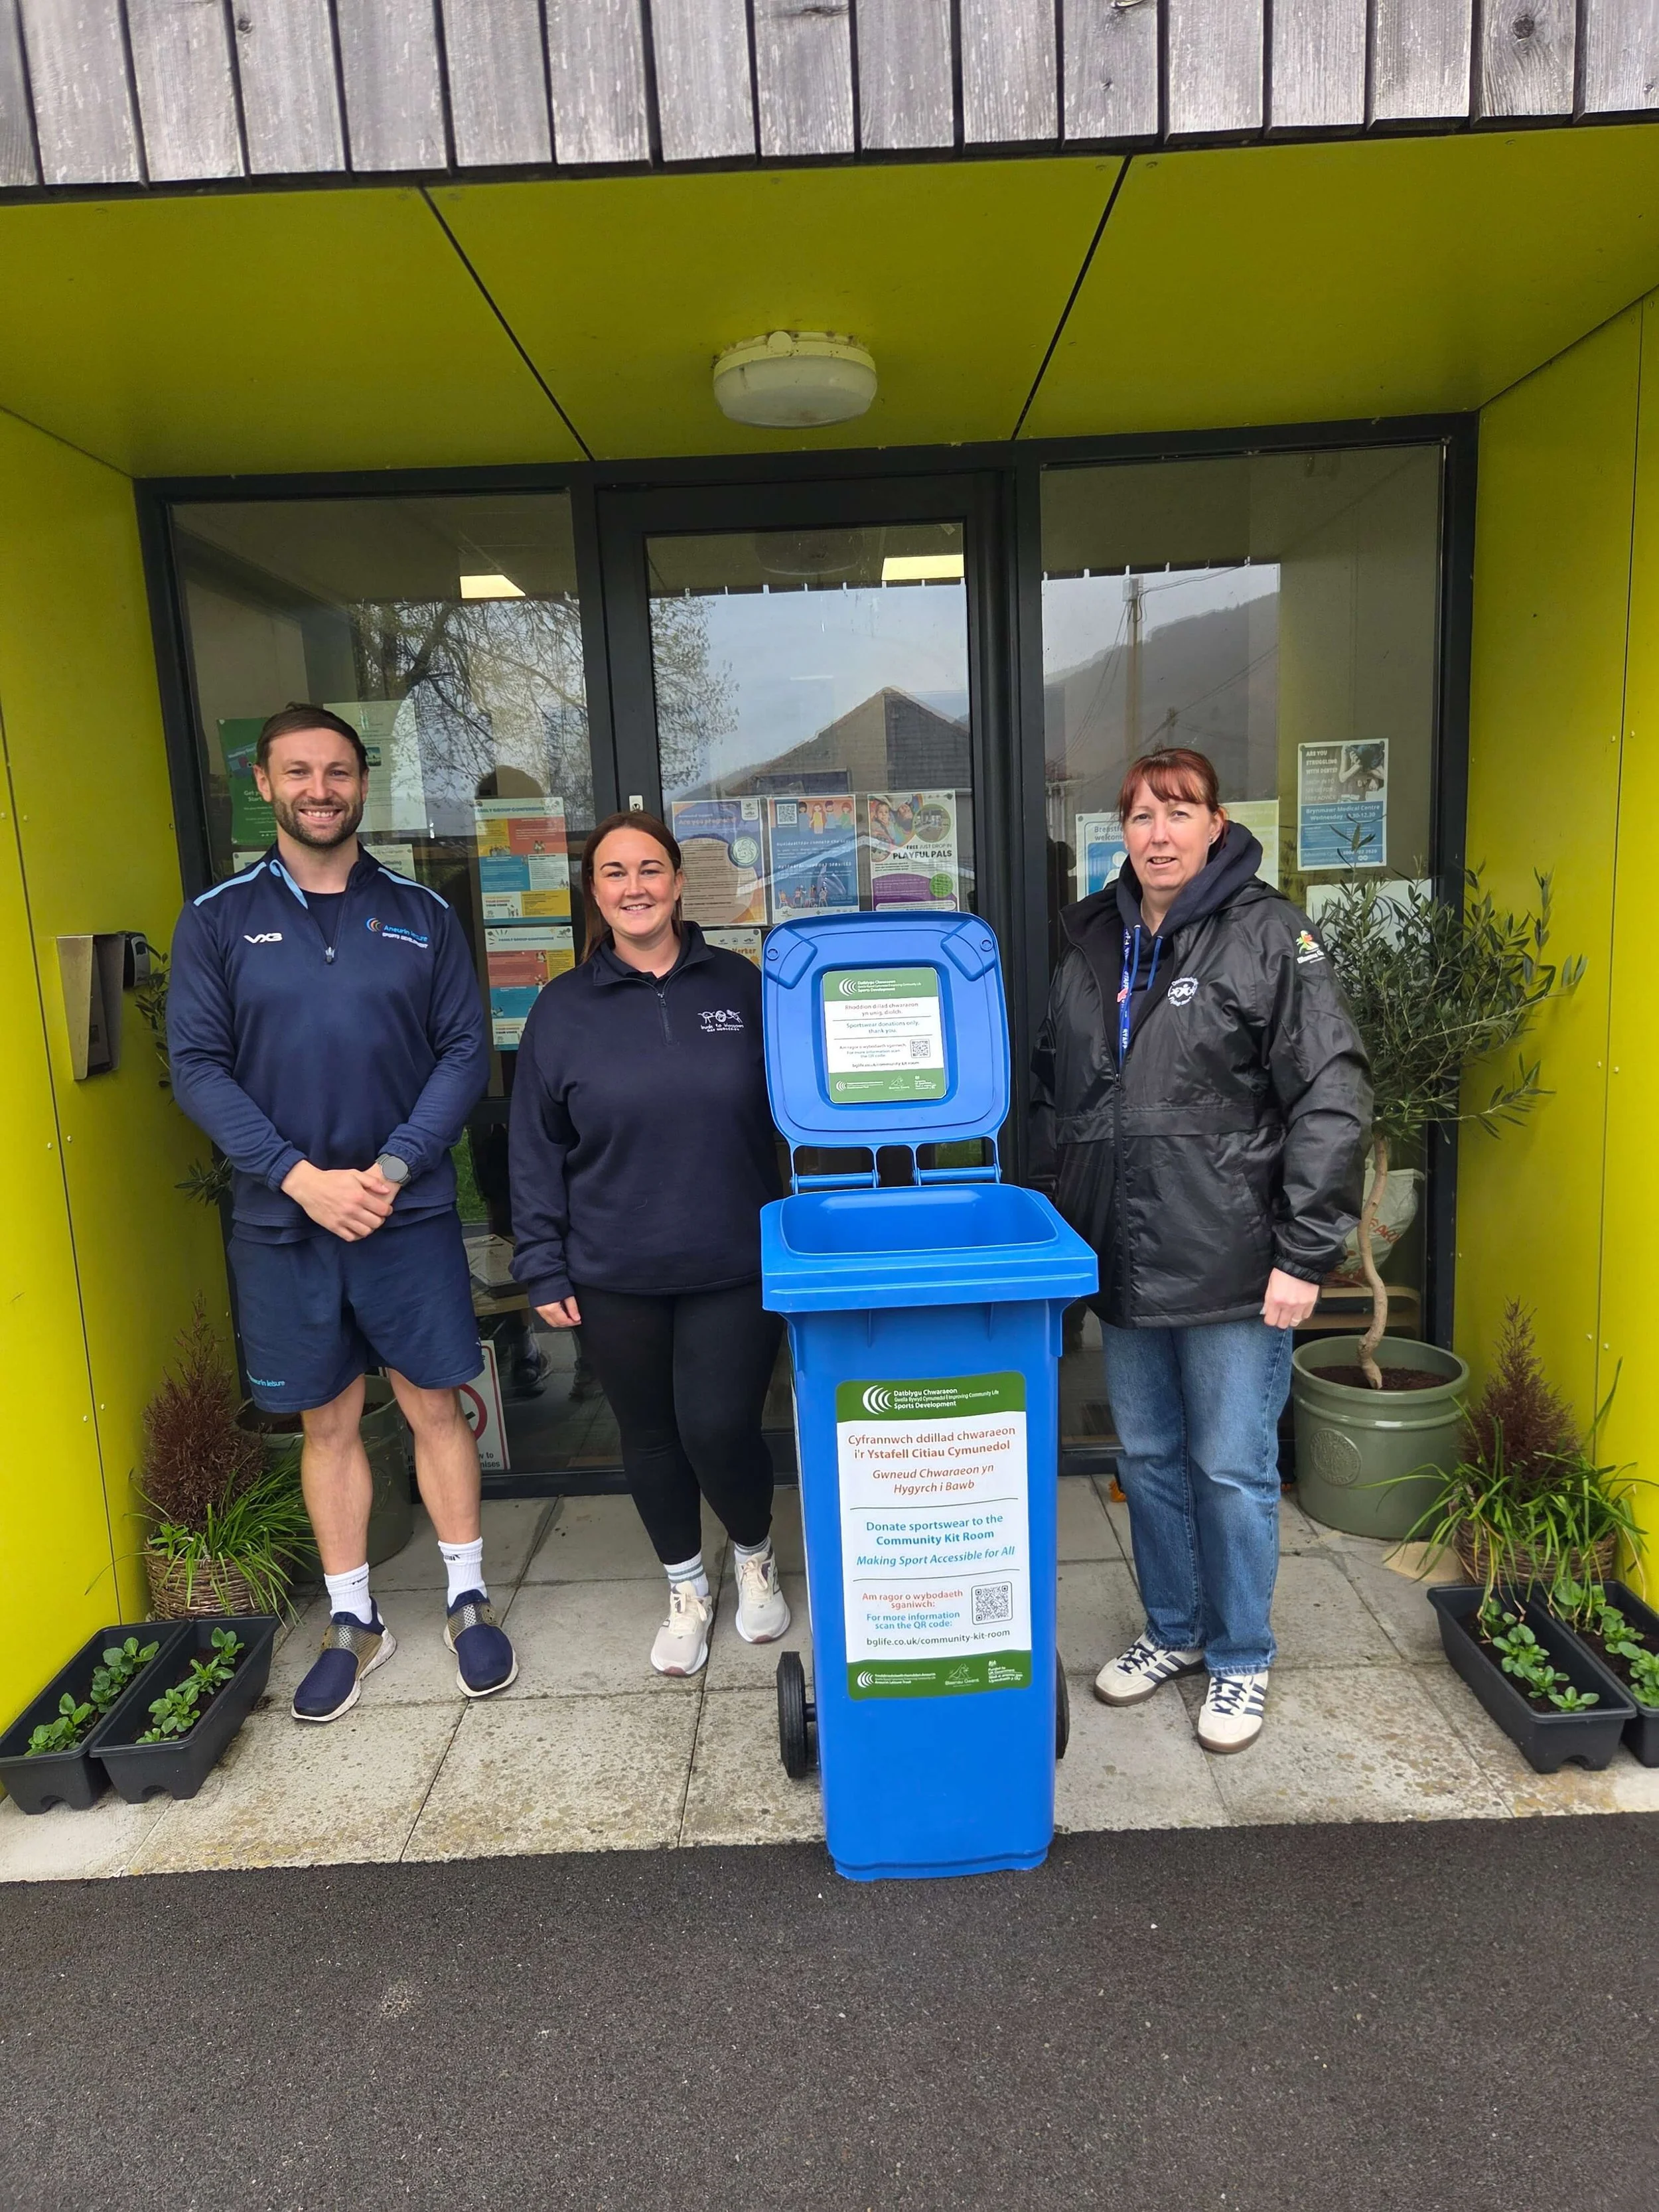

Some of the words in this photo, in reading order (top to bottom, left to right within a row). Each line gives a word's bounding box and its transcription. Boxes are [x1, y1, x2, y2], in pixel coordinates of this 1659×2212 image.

[893, 851, 930, 859] PLAYFUL
[244, 932, 283, 943] VX3
[384, 925, 410, 936] Aneurin
[848, 1434, 913, 1446] Cyfrannwch
[916, 1432, 954, 1443] ddillad
[957, 1427, 1016, 1441] chwaraeon
[855, 1449, 865, 1459] i'r
[867, 1449, 908, 1459] Ystafell
[912, 1447, 944, 1458] Citiau
[948, 1440, 1010, 1457] Cymunedol
[873, 1469, 917, 1479] Gwneud
[919, 1466, 979, 1478] Chwaraeon
[981, 1464, 994, 1475] yn
[894, 1482, 937, 1495] Hygyrch
[940, 1482, 944, 1491] i
[946, 1480, 975, 1491] Bawb
[866, 1521, 906, 1531] Donate
[909, 1519, 970, 1532] sportswear
[972, 1516, 983, 1526] to
[985, 1514, 1003, 1524] the
[876, 1535, 942, 1546] Community
[944, 1534, 960, 1542] Kit
[963, 1531, 995, 1541] Room
[856, 1555, 896, 1567] Making
[899, 1555, 927, 1566] Sport
[930, 1551, 982, 1564] Accessible
[983, 1549, 999, 1560] for
[1001, 1546, 1015, 1556] All
[879, 1593, 902, 1602] ragor
[913, 1589, 963, 1601] wybodaeth
[891, 1601, 936, 1610] sganiwch:
[908, 1611, 960, 1621] information
[897, 1621, 912, 1629] the
[914, 1621, 926, 1629] QR
[928, 1619, 953, 1628] code:
[867, 1629, 1010, 1647] bglife.co.uk/community-kit-room
